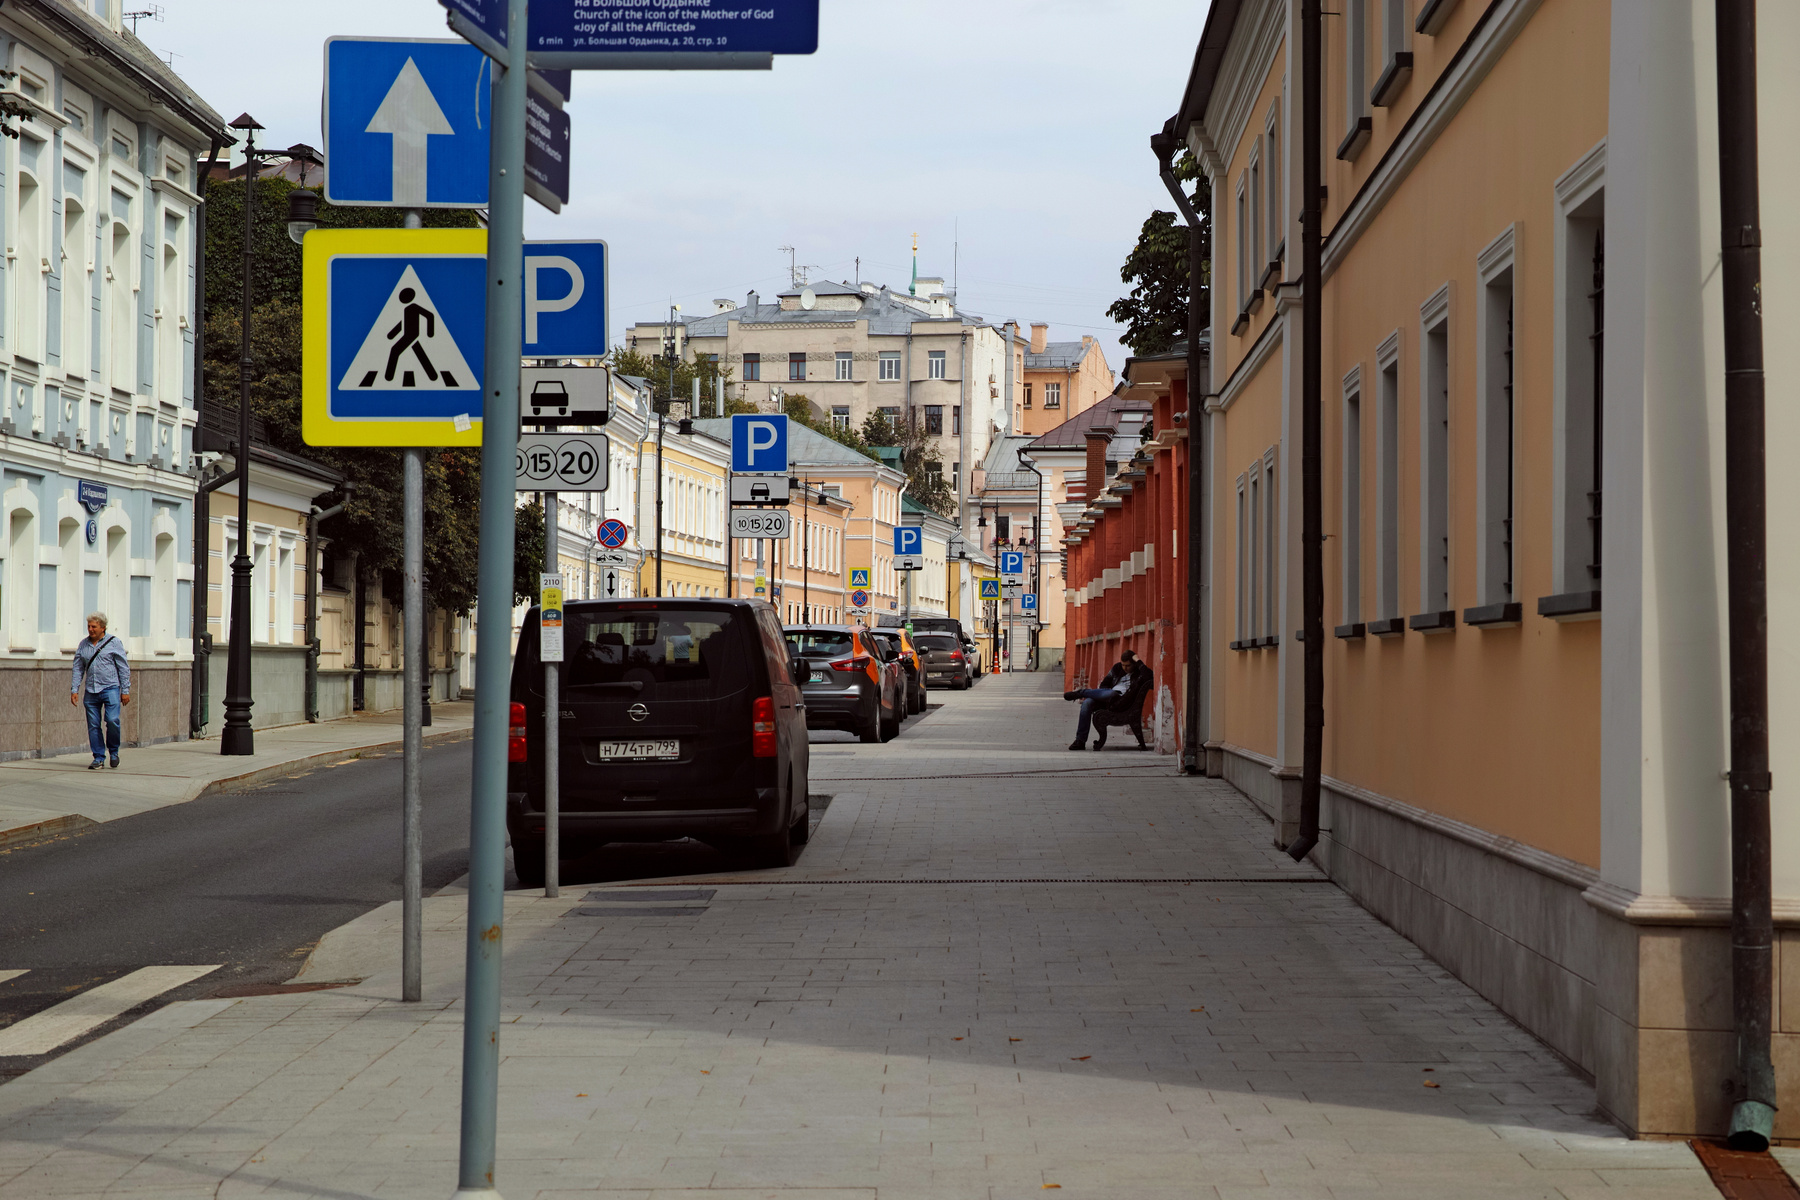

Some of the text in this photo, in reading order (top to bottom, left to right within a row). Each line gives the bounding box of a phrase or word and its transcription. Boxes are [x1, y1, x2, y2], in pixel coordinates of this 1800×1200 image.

[574, 9, 774, 19] Church of the icon of the Mother of God
[574, 22, 696, 34] «Joy of all the Afflicted»
[539, 36, 563, 45] 6 min
[573, 36, 727, 47] ул. Большая Ордынка, д. 20, стр. 10
[524, 255, 585, 345] P
[747, 420, 778, 466] P
[530, 452, 551, 473] 15
[560, 450, 594, 475] 20
[737, 517, 782, 530] 10 15 20
[901, 529, 917, 553] P
[1006, 554, 1020, 572] P
[543, 578, 560, 586] 2110
[1025, 595, 1034, 608] P
[656, 741, 676, 751] 799
